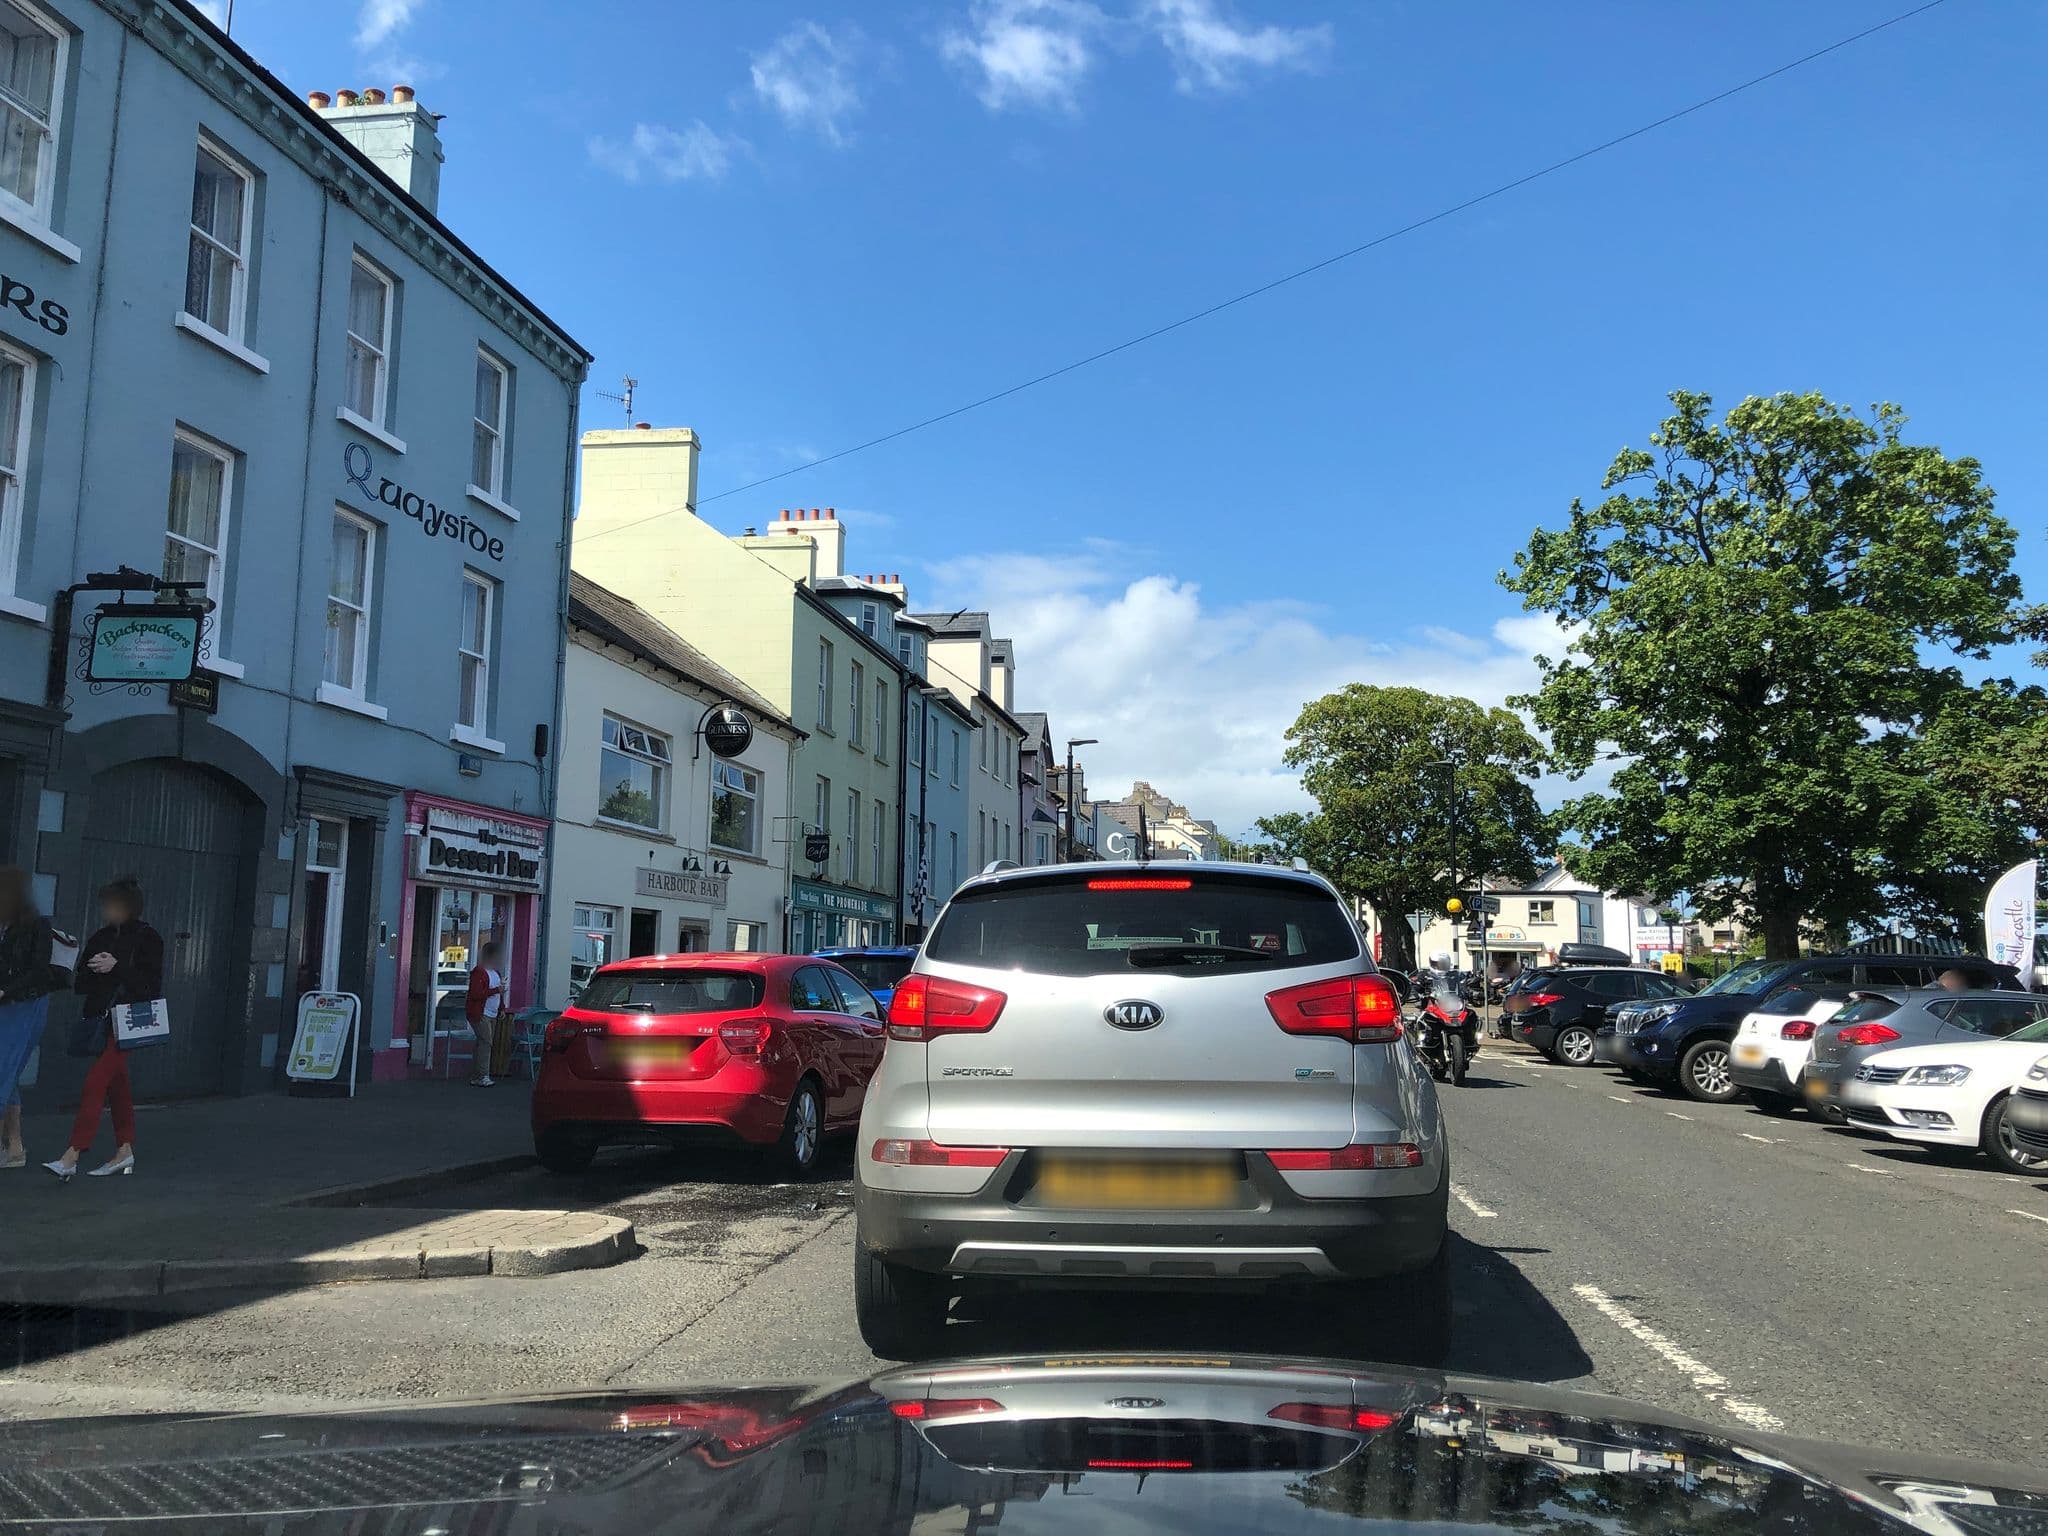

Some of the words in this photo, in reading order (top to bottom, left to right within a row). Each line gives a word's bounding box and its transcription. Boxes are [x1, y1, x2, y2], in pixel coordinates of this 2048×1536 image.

[344, 442, 504, 562] Quayside
[97, 621, 191, 649] Backpackers
[707, 724, 748, 735] GUINNESS
[429, 837, 506, 875] Dessert
[507, 850, 539, 880] Bar
[647, 872, 697, 896] HARBOUR
[700, 881, 719, 899] BAR
[823, 893, 835, 907] THE
[836, 896, 868, 912] PROMENADE
[1114, 1006, 1155, 1024] KIA
[942, 1067, 1014, 1077] SPORTAGE
